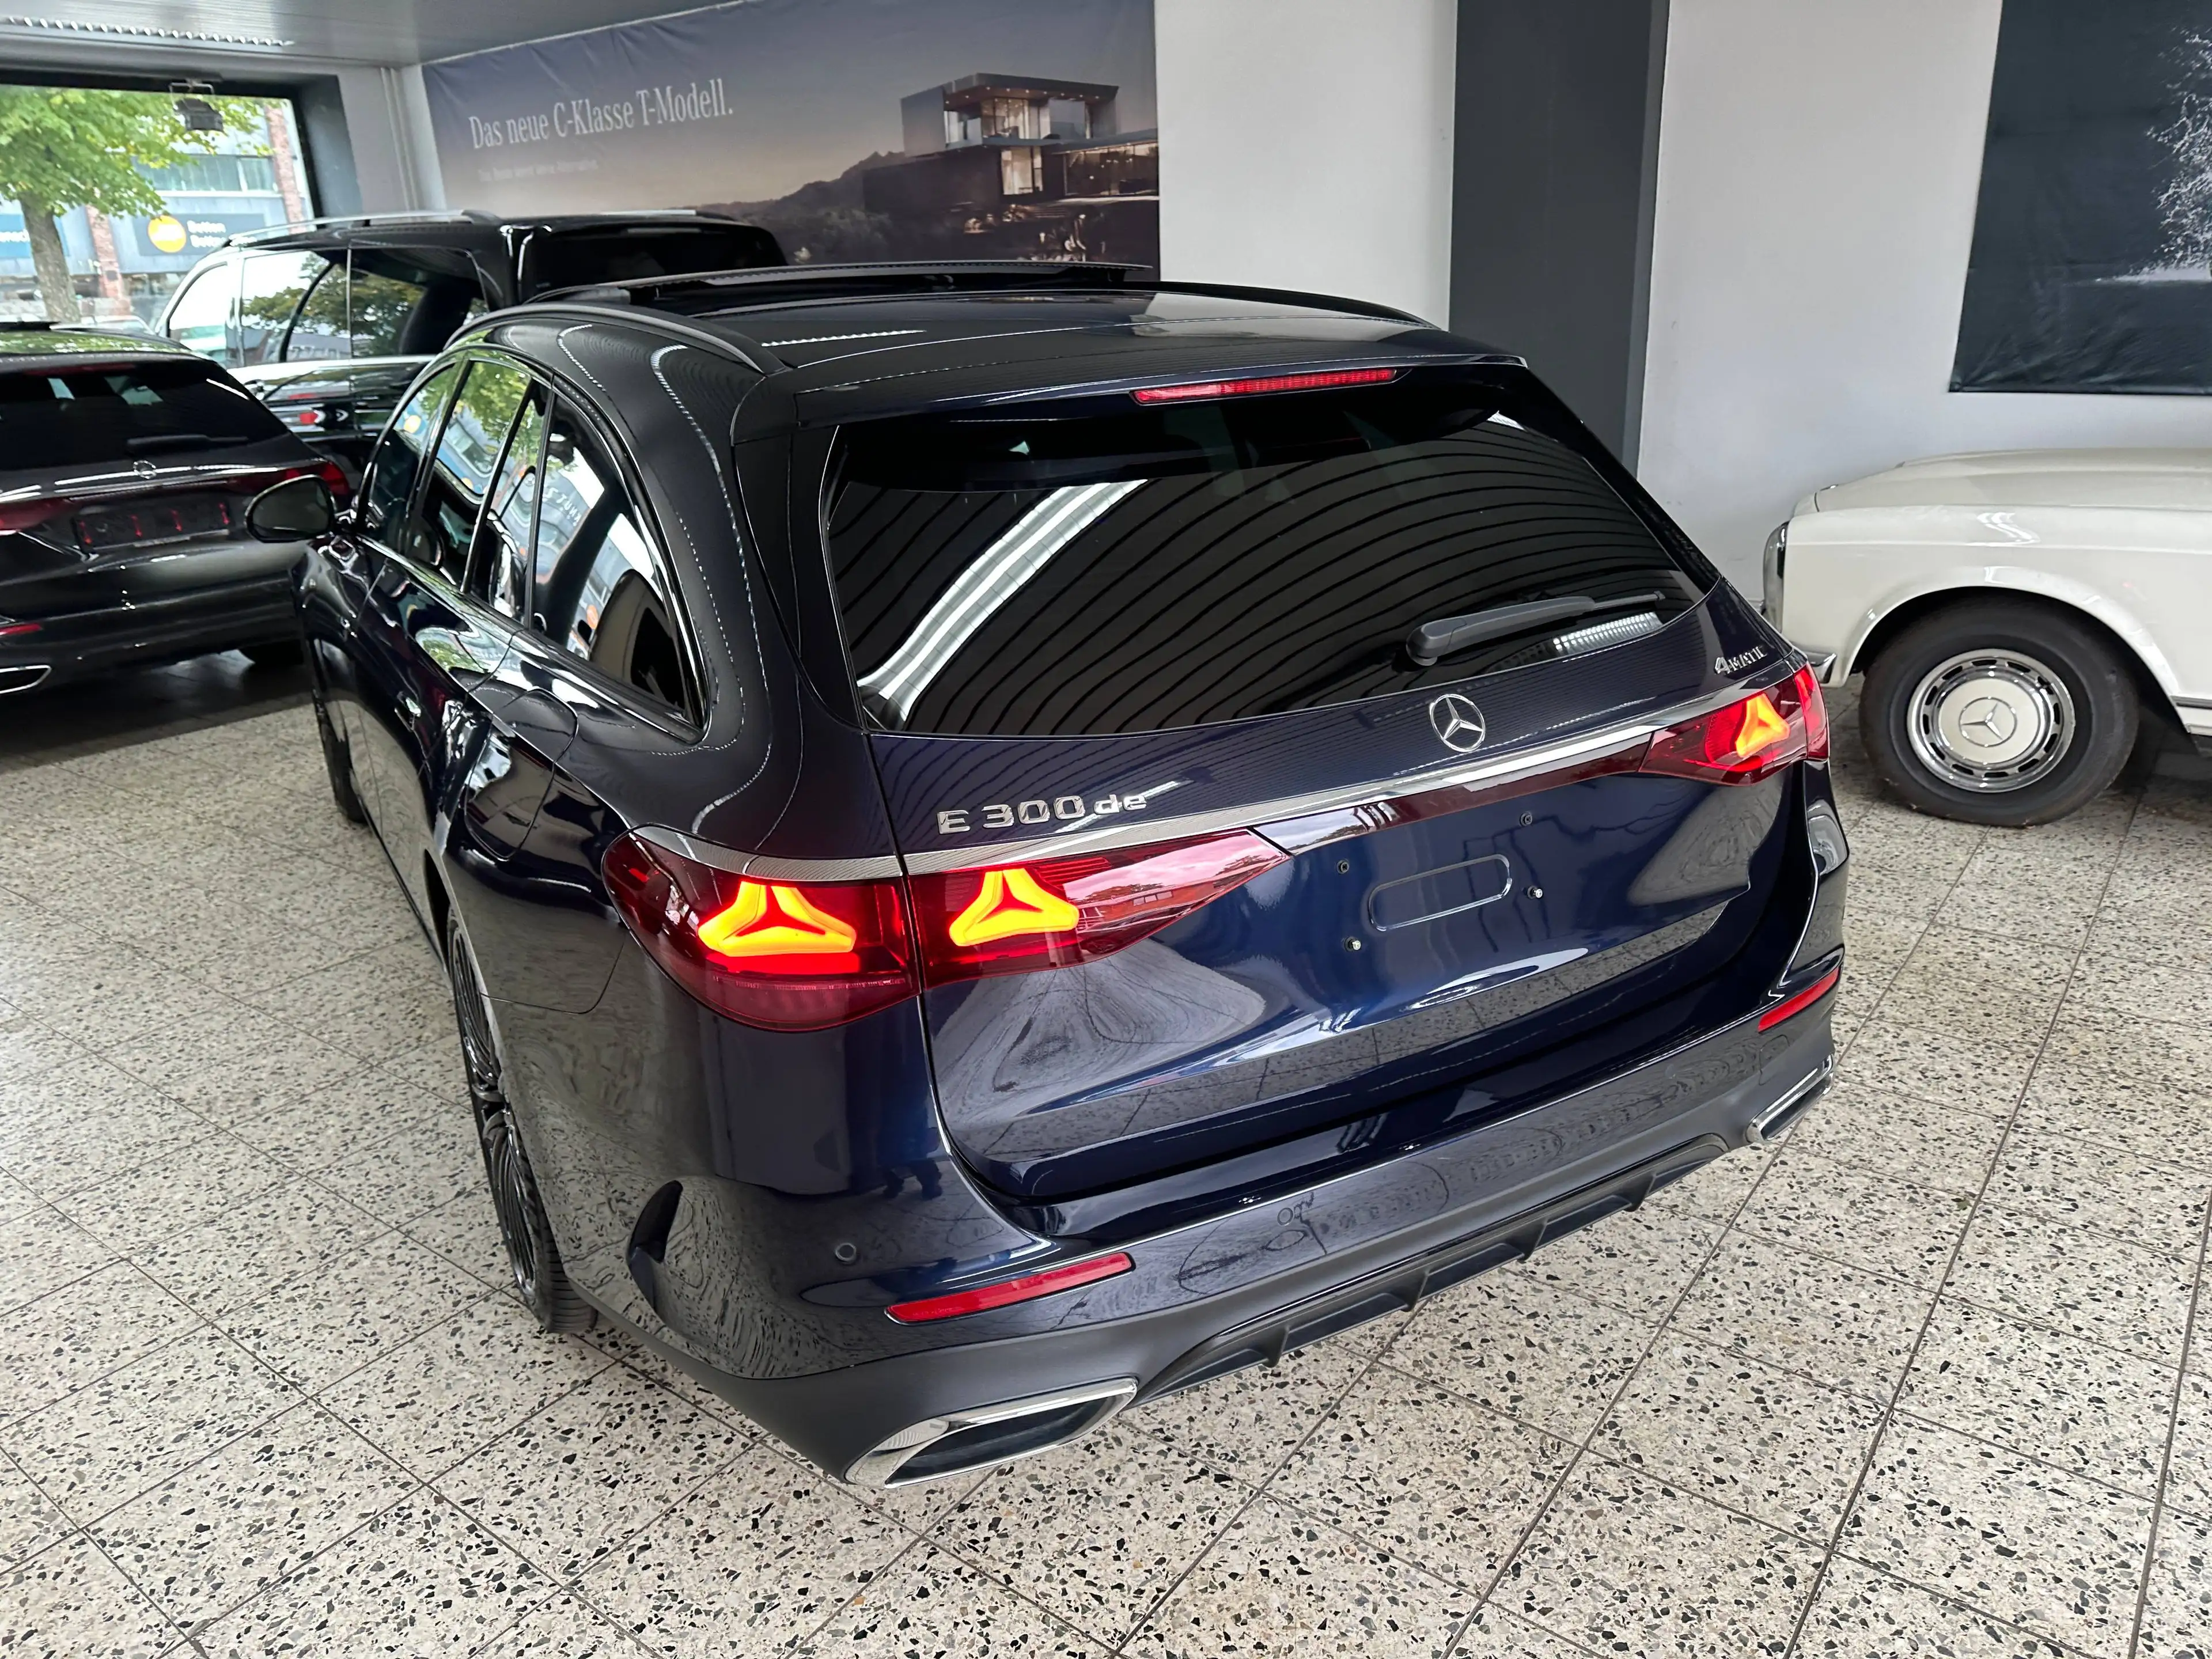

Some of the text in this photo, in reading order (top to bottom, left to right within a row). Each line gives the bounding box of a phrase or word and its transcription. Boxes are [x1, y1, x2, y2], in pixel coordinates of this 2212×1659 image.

[468, 78, 733, 149] Das neue C-Klasse T-Modell.
[937, 793, 1147, 835] E 300 de
